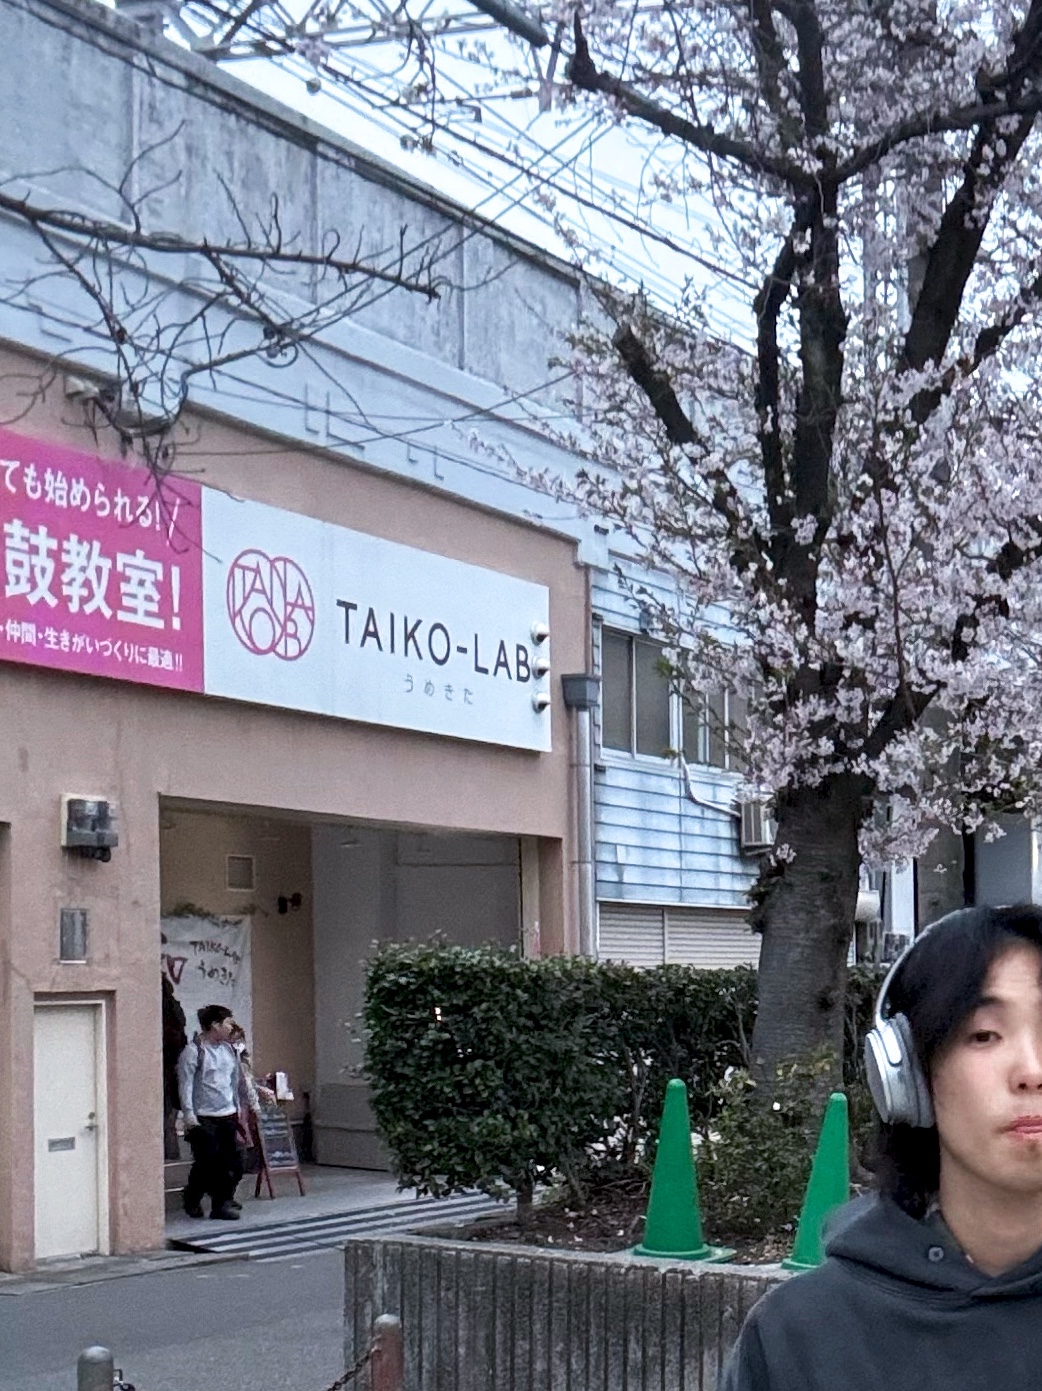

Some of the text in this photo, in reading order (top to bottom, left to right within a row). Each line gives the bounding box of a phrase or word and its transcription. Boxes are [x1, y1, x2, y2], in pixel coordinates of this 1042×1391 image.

[3, 518, 181, 630] 鼓教室!
[336, 599, 531, 683] TAIKO-LAB
